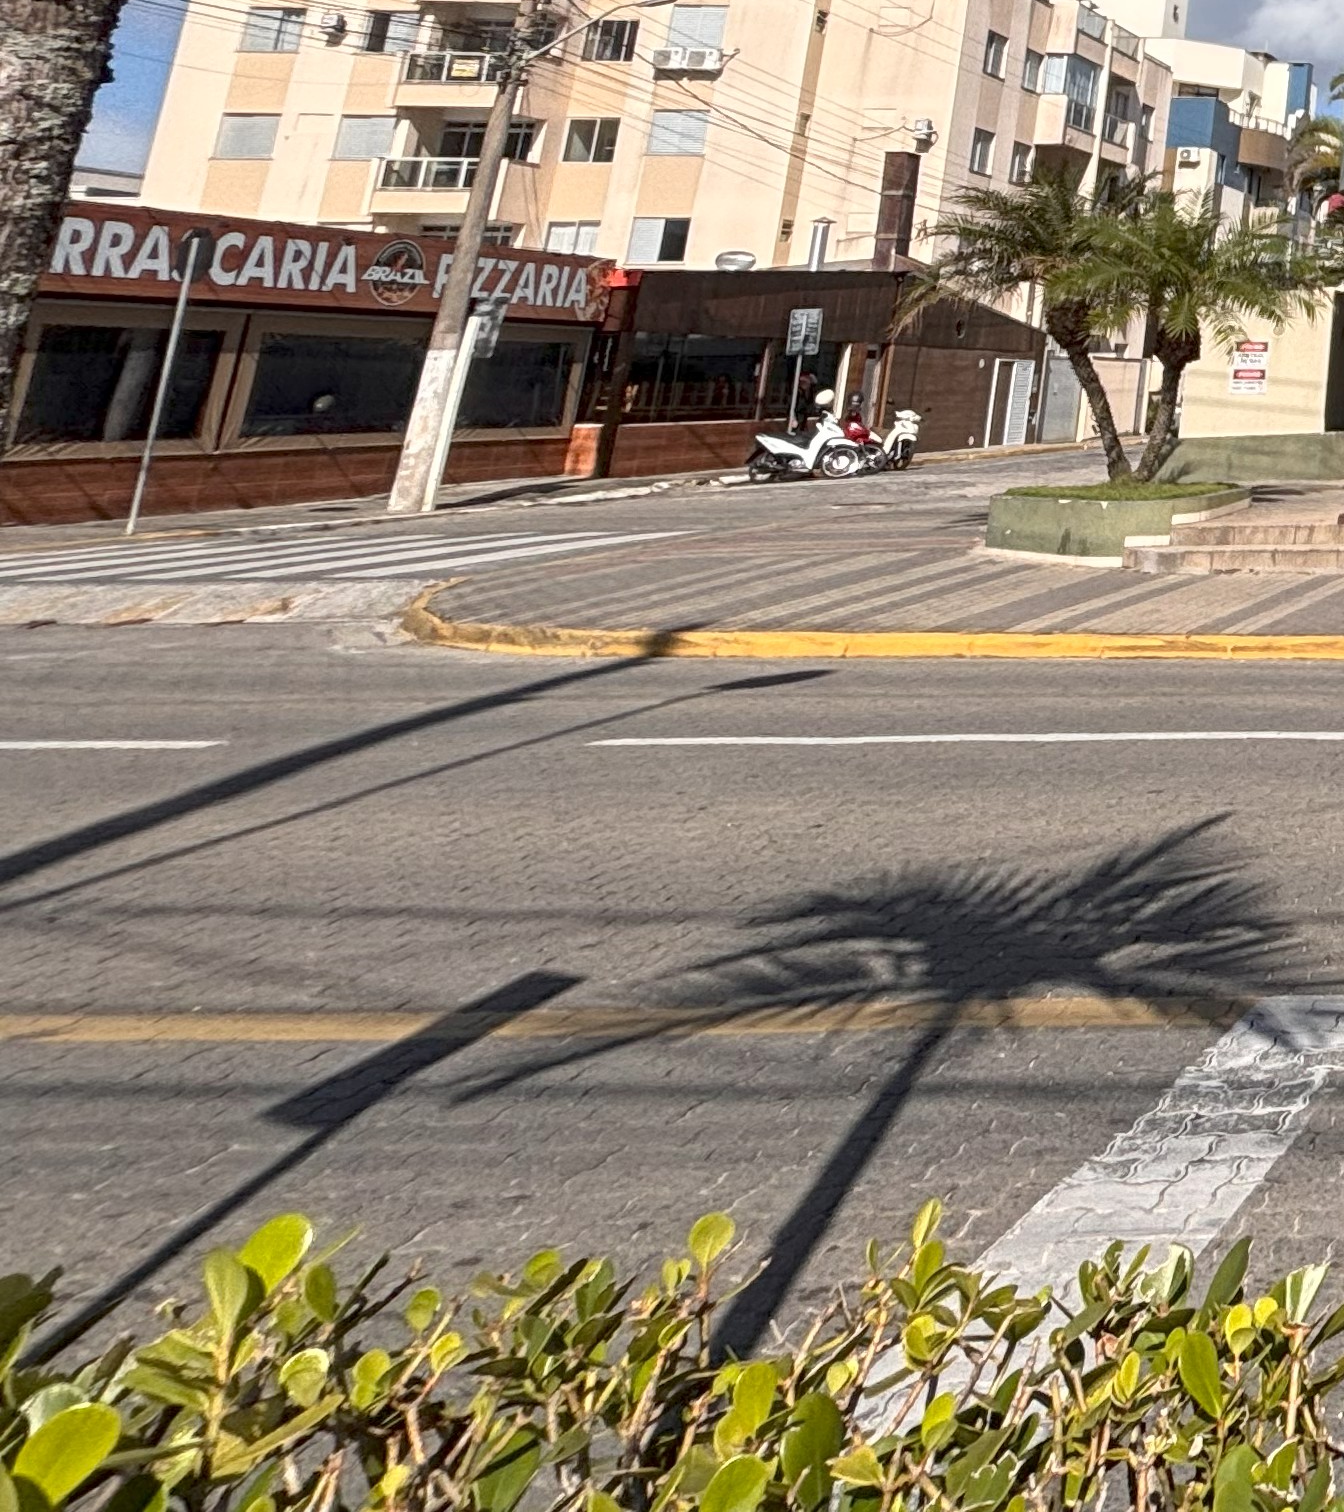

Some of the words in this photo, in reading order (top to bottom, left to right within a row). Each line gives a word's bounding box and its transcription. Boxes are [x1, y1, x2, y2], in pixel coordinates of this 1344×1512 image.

[49, 216, 356, 292] RRACARIA
[361, 265, 430, 285] BRAZIL
[432, 253, 588, 308] PZZARIA
